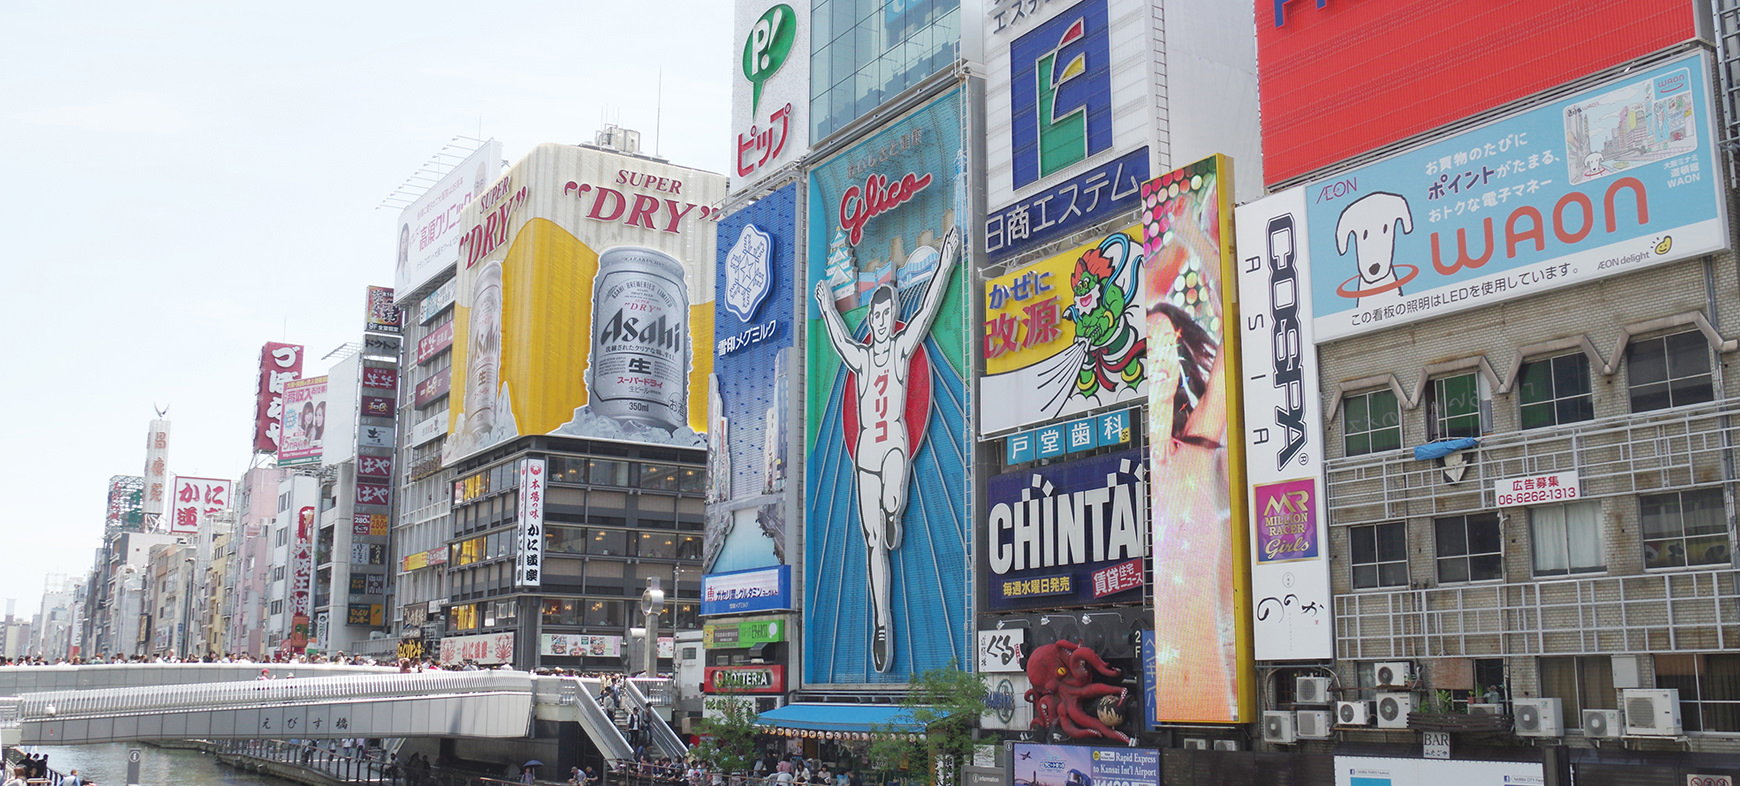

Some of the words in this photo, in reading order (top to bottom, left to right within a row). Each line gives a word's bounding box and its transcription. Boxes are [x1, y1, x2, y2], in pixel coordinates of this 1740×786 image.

[737, 102, 792, 178] ピップ
[1425, 132, 1529, 176] お買物のたびに
[616, 169, 683, 195] SUPER
[1667, 173, 1701, 189] WAON
[480, 176, 511, 215] SUPER
[985, 162, 1139, 254] 日商エステム
[1428, 178, 1553, 224] おトクな電子マネー
[839, 172, 932, 247] Glico
[1620, 251, 1650, 266] delight
[989, 270, 1055, 310] かぜに
[1350, 262, 1579, 326] この看板の照明はLEDを使用しています。
[600, 307, 681, 354] Asahi
[717, 319, 777, 357] 雪印メグミルク
[983, 295, 1062, 360] 改源
[1245, 255, 1269, 445] ASIA
[628, 357, 652, 375] 生
[617, 376, 664, 389] スーパードライ
[628, 401, 650, 412] 350ml
[873, 368, 890, 444] グリコ
[1012, 413, 1124, 460] 戸堂歯科
[179, 482, 226, 506] かに
[1498, 487, 1576, 505] 06-6262-1313
[1513, 475, 1559, 491] 広告募集
[529, 478, 541, 520] 本場の味
[1263, 490, 1310, 517] MR
[1265, 512, 1308, 527] MILLION
[1269, 523, 1306, 537] RACER
[525, 523, 540, 582] かに道楽
[1265, 536, 1310, 560] Girls
[1093, 568, 1120, 596] 賃貸
[1119, 562, 1135, 579] 住宅
[1119, 571, 1143, 589] ニュース
[1002, 576, 1071, 597] 毎週水曜日発売
[262, 716, 348, 730] えびす橋
[1424, 733, 1449, 746] BAR
[1093, 765, 1099, 773] to
[1100, 764, 1120, 774] Kansai
[1134, 766, 1157, 779] Airport
[1116, 752, 1133, 764] Rapid
[1134, 753, 1157, 766] Express
